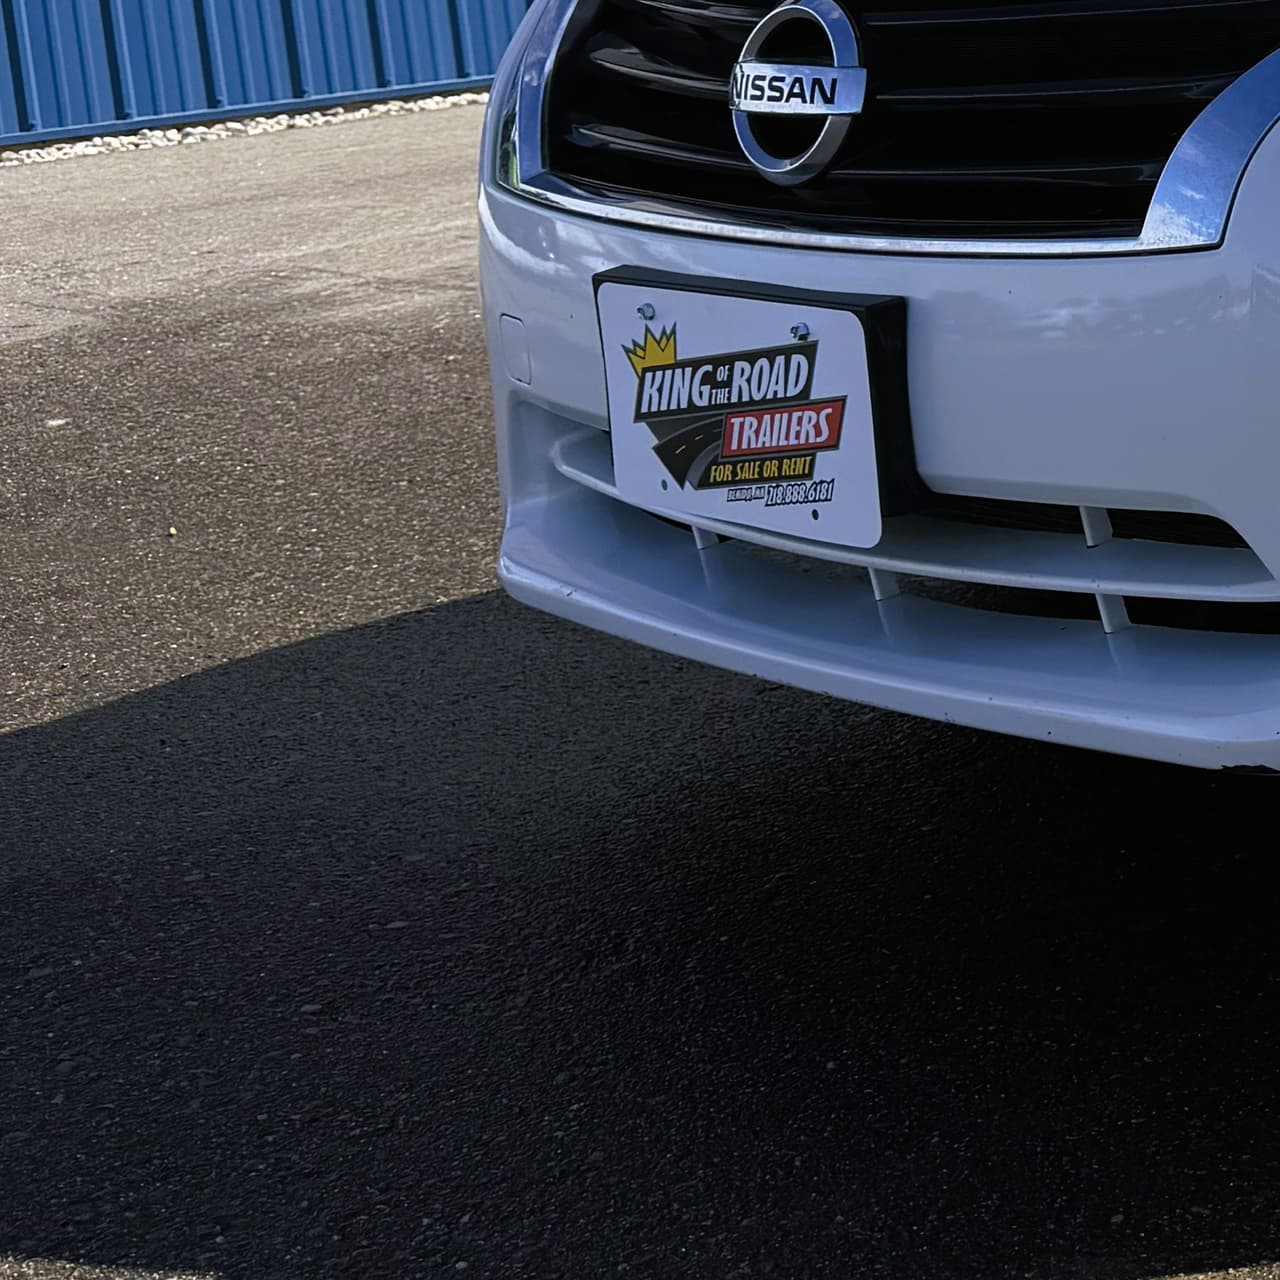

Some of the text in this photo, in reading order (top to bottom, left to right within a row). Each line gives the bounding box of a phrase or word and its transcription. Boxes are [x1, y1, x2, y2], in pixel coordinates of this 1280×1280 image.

[731, 71, 838, 105] NISSAN
[641, 353, 809, 413] KING OF THE ROAD
[730, 408, 832, 450] TRAILERS
[709, 456, 812, 483] FOR SALE OR RENT
[764, 479, 834, 507] 218.888.6181
